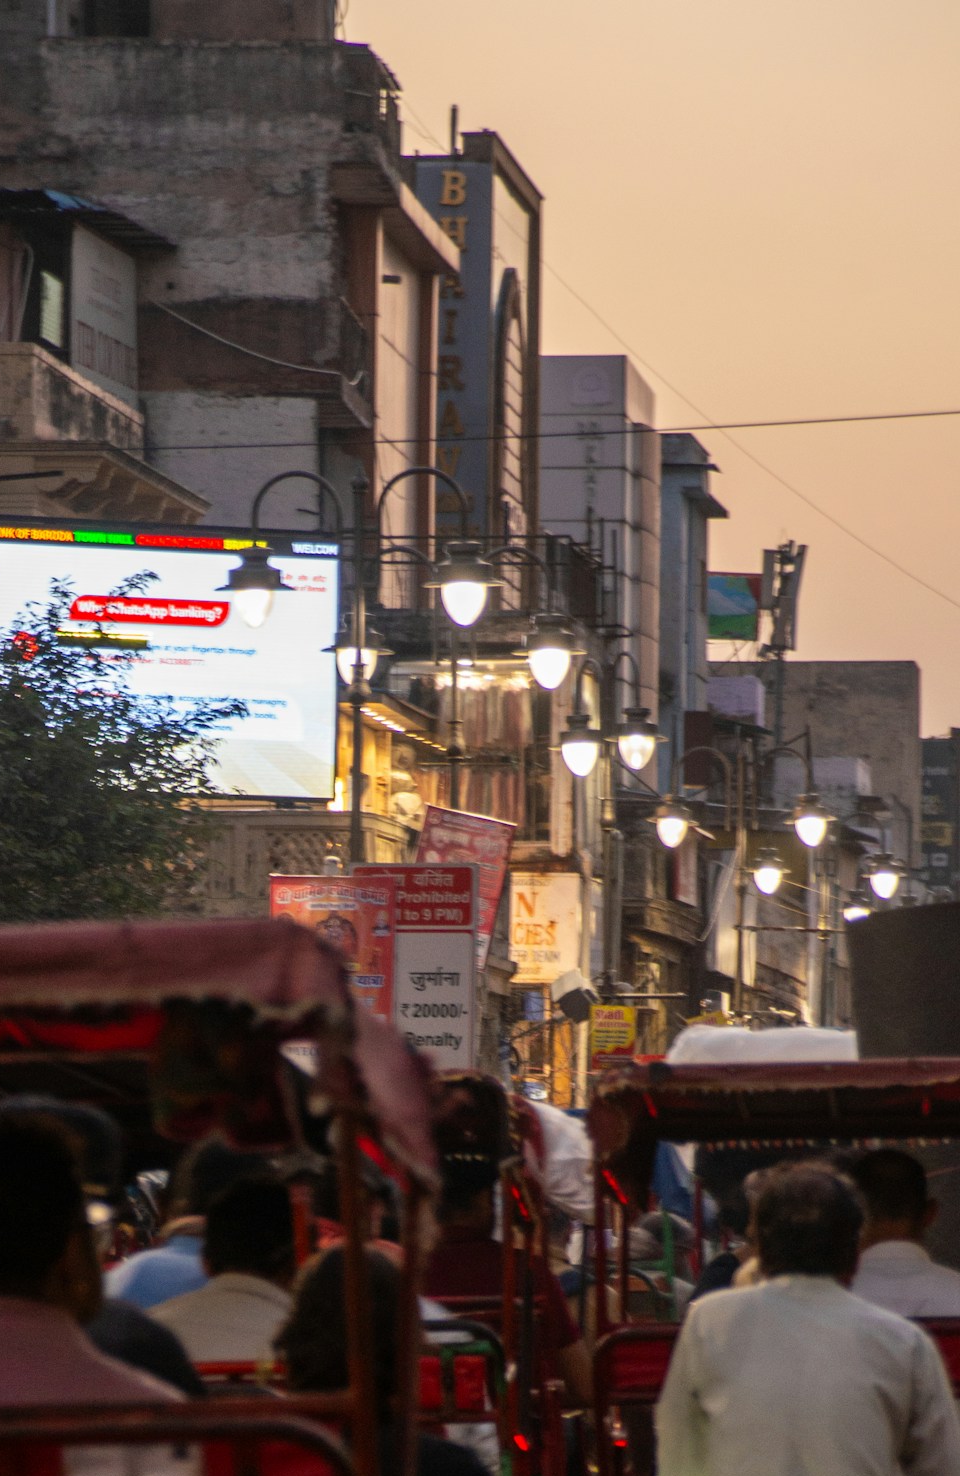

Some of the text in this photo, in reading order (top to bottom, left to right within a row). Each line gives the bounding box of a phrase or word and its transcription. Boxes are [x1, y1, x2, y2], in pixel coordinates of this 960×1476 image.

[31, 529, 74, 542] BARODA
[106, 602, 169, 620] WhatsApp
[169, 604, 224, 622] banking?
[396, 890, 470, 904] Prohibited
[403, 907, 464, 924] to 9 PM)
[409, 966, 460, 992] जुर्माना
